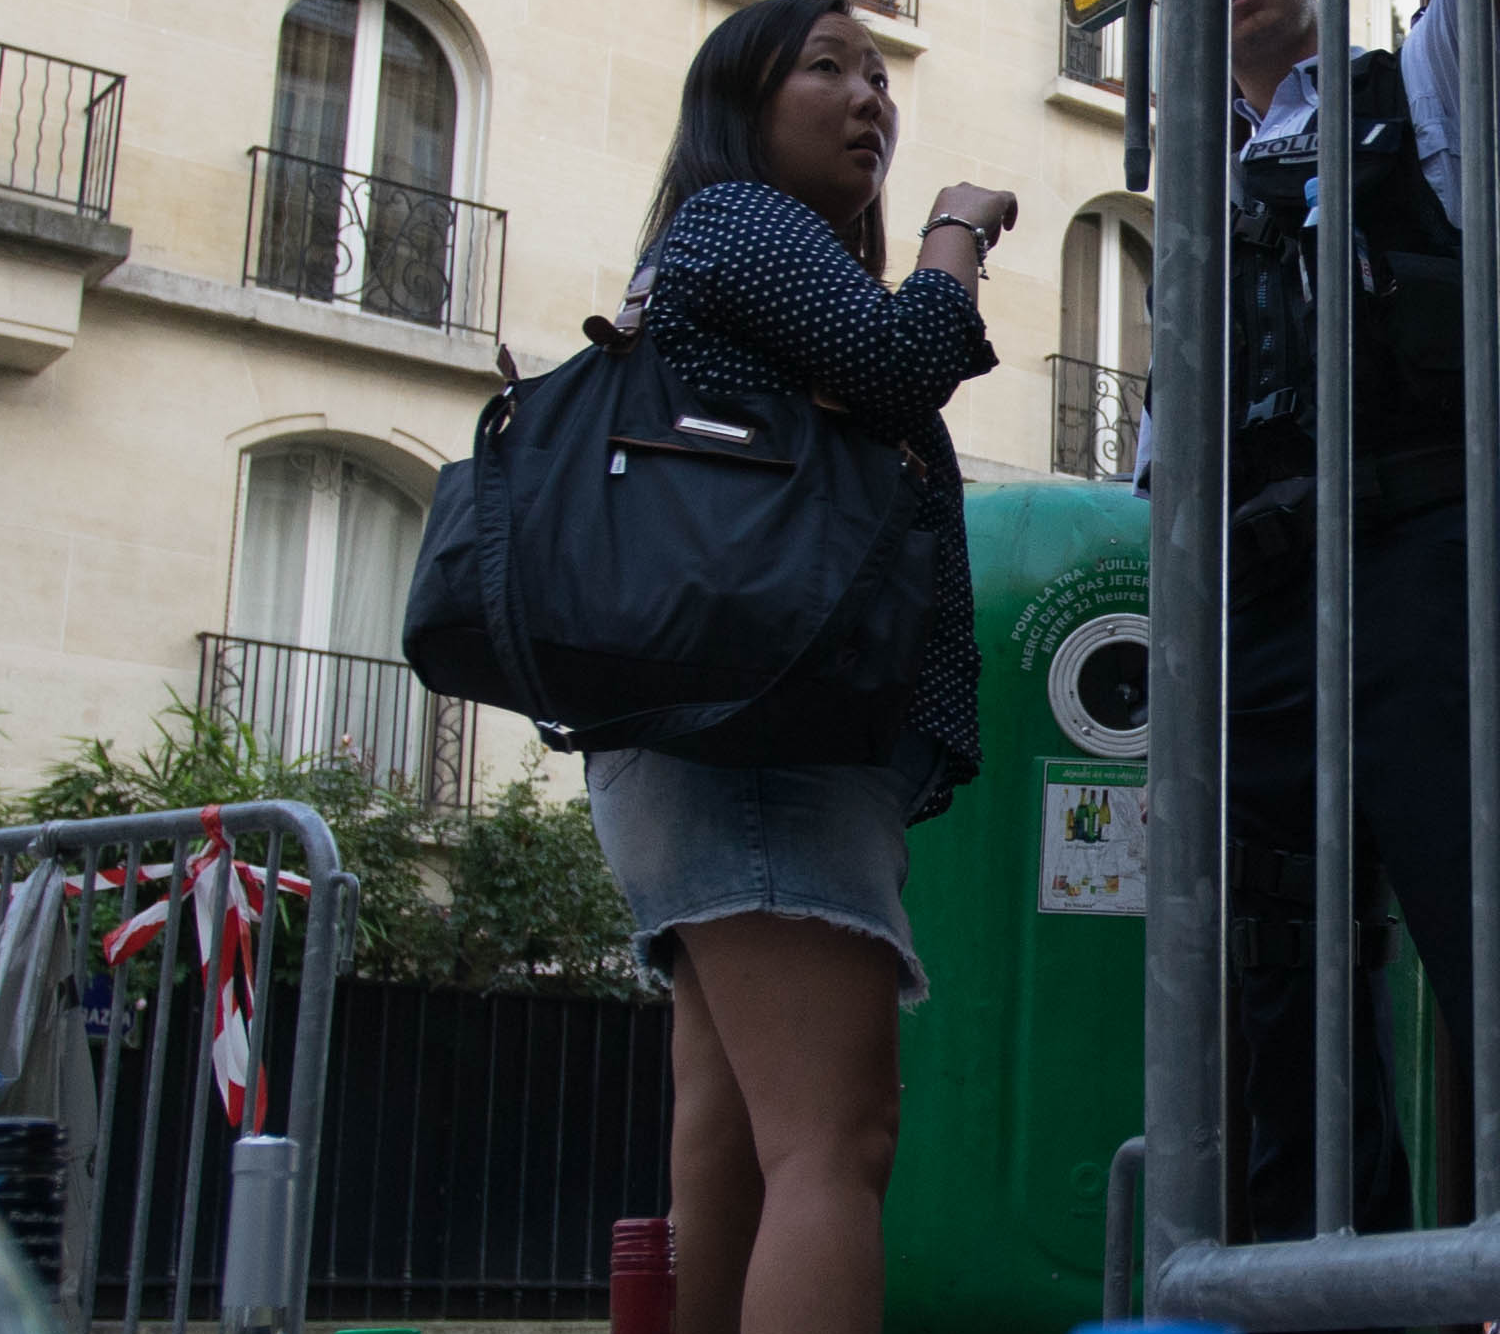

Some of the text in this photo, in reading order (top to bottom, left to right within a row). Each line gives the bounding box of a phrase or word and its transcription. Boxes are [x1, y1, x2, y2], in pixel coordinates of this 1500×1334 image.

[1249, 132, 1318, 158] POLI
[1011, 603, 1039, 641] POUR
[1036, 586, 1056, 604] LA
[1021, 624, 1044, 671] MERCI
[1039, 605, 1058, 624] DE
[1056, 589, 1075, 608] NE
[1077, 577, 1105, 605] PAS
[1041, 610, 1075, 654] ENTRE
[1094, 591, 1146, 605] heures
